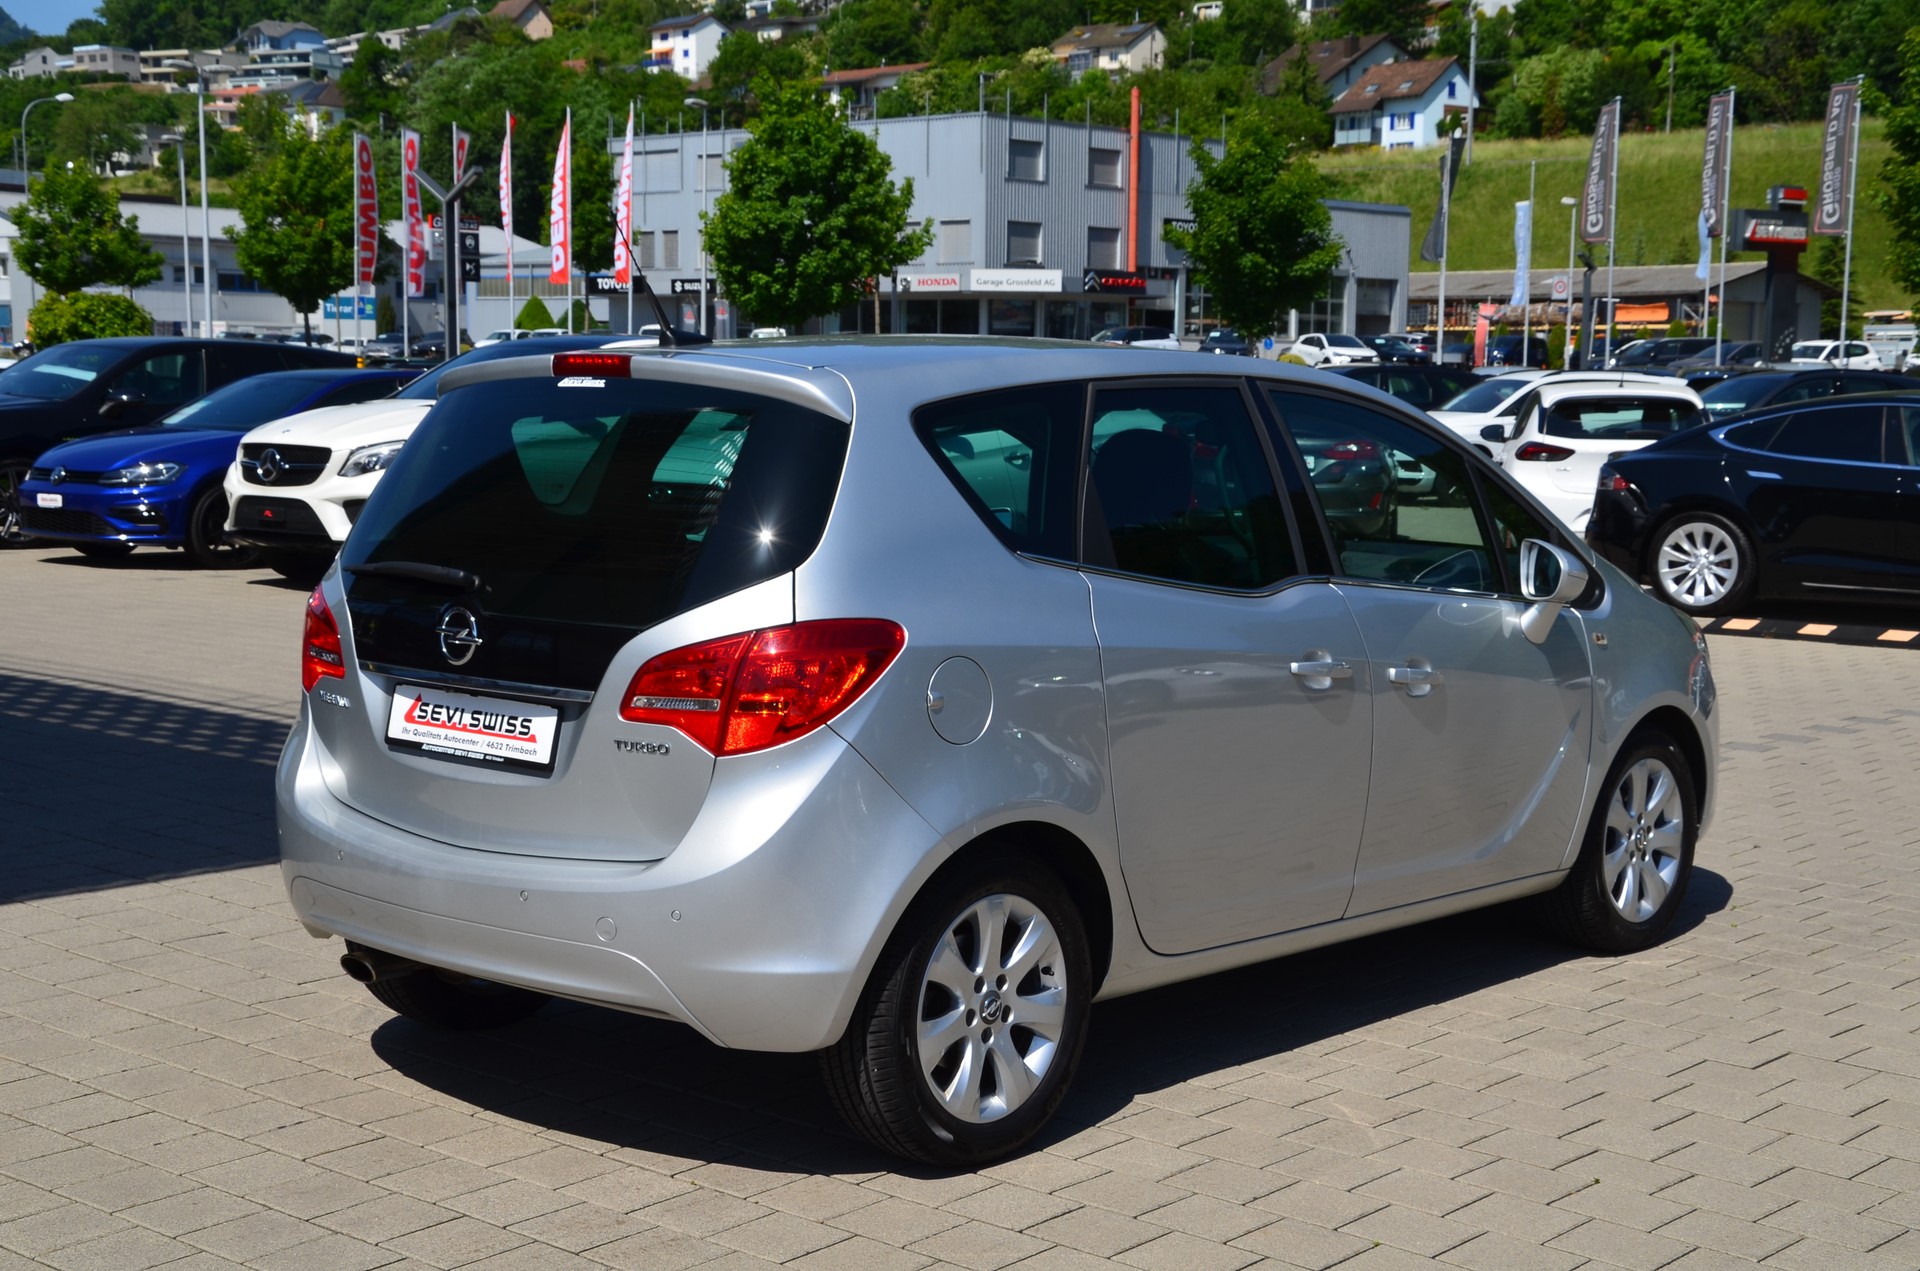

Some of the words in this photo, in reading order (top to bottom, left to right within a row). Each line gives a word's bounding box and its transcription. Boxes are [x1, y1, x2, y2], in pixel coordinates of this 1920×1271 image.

[359, 140, 377, 282] JUMBO
[405, 137, 426, 293] JUMBO
[917, 278, 957, 287] HONDA
[976, 278, 1004, 287] Garage
[1006, 278, 1042, 286] Grossfeld
[416, 702, 465, 726] SEVI
[469, 710, 533, 737] SWISS
[401, 726, 411, 736] Ihr
[443, 734, 480, 748] Autocenter
[486, 741, 504, 751] 4632
[504, 743, 538, 757] Trimbach
[613, 739, 670, 755] TURBO
